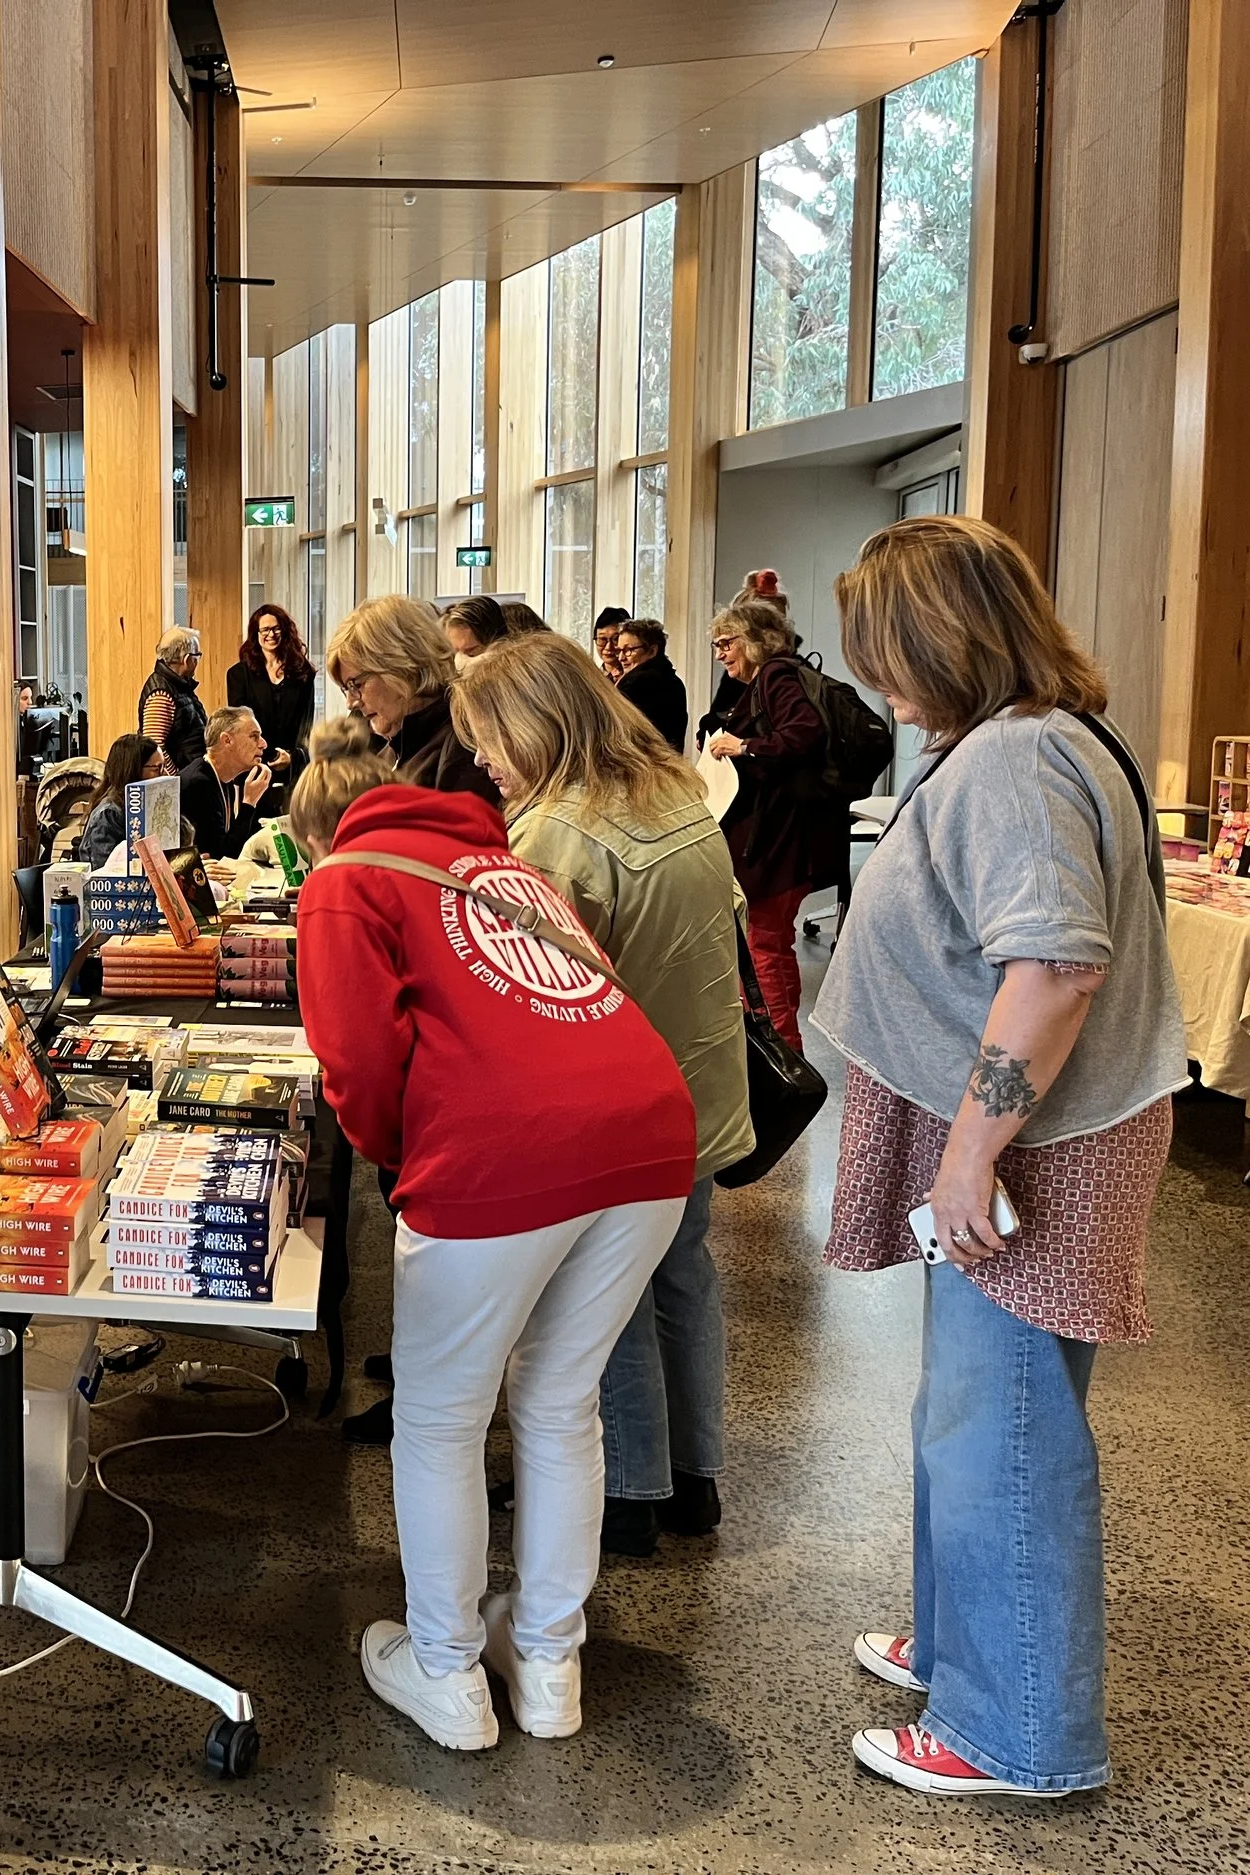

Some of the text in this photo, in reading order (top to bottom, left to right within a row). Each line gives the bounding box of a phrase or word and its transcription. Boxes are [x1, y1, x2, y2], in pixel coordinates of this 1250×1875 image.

[129, 785, 141, 814] 1000
[440, 887, 511, 995] HIGH THINKING
[530, 997, 587, 1023] LIVING
[0, 1091, 16, 1116] WIRE
[169, 1105, 188, 1116] JANE
[189, 1106, 211, 1117] CARO
[6, 1157, 32, 1167] HIGH
[34, 1158, 59, 1169] WIRE
[119, 1200, 188, 1219] CANDICE FOX
[208, 1204, 244, 1216] DEVIL'S
[204, 1213, 248, 1224] KITCHEN
[25, 1221, 52, 1232] WIRE
[118, 1228, 187, 1245] CANDICE FOX
[208, 1232, 243, 1243] DEVIL'S
[20, 1246, 46, 1257] WIRE
[204, 1241, 247, 1252] KITCHEN
[115, 1250, 184, 1269] CANDICE FOX
[204, 1256, 240, 1268] DEVIL'S
[200, 1265, 244, 1276] KITCHEN
[18, 1274, 45, 1286] WIRE
[122, 1274, 192, 1292] CANDICE FOX
[212, 1278, 248, 1289] DEVIL'S
[208, 1287, 252, 1298] KITCHEN
